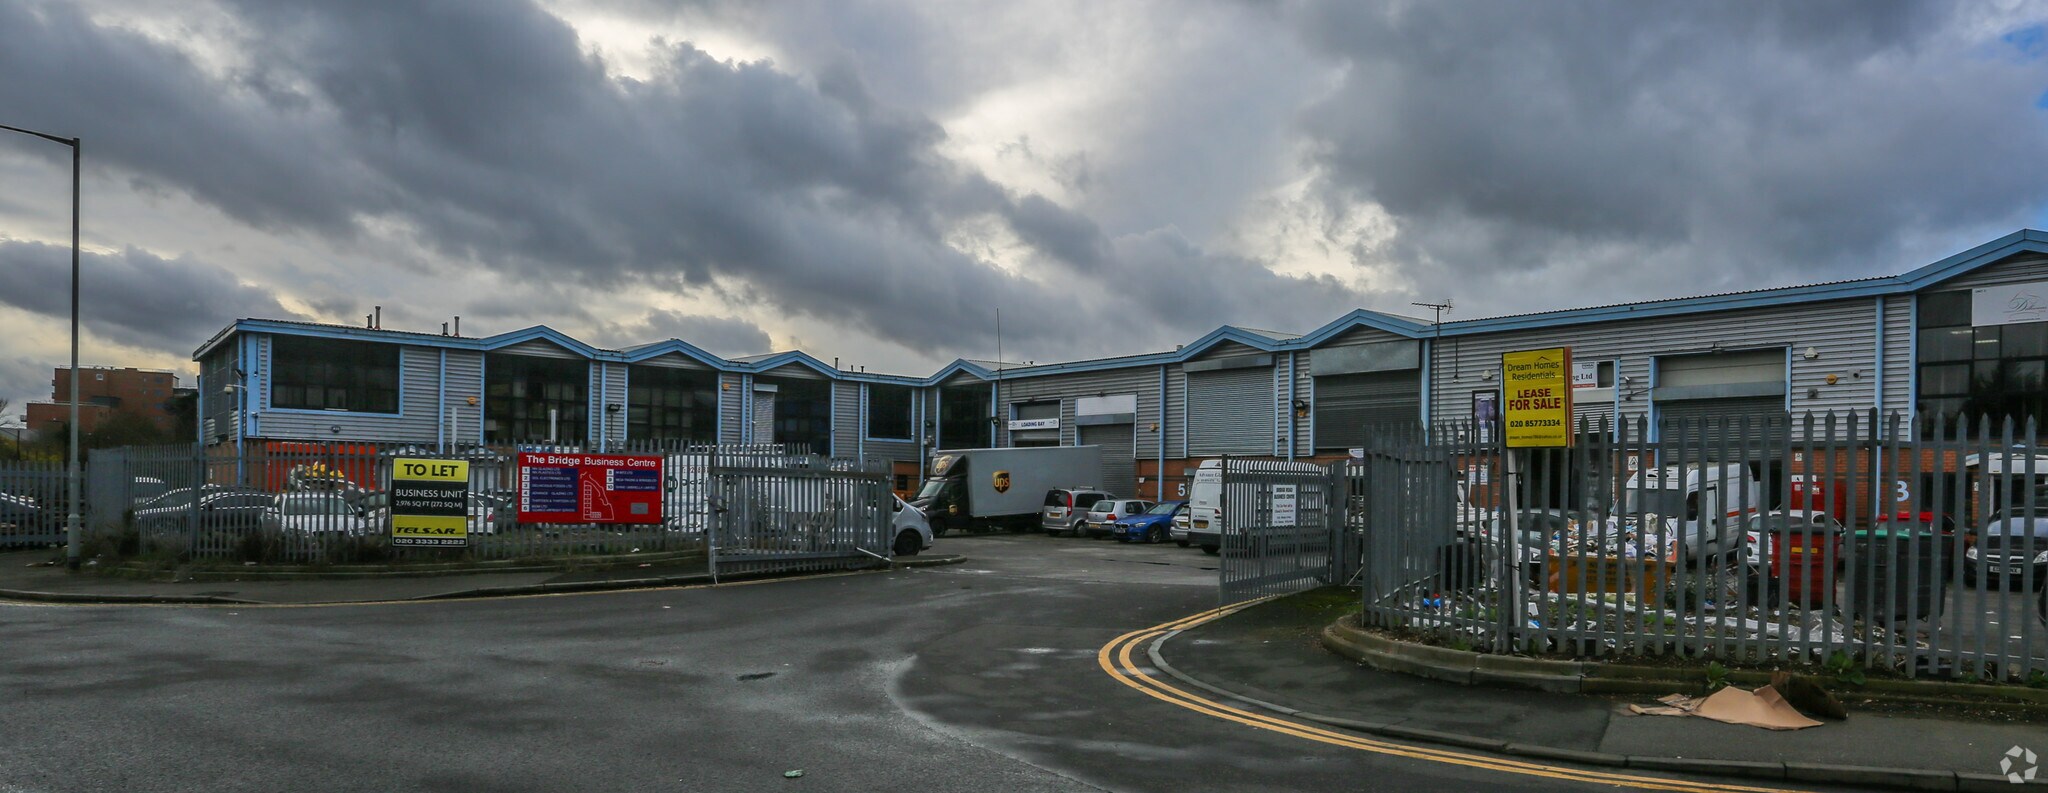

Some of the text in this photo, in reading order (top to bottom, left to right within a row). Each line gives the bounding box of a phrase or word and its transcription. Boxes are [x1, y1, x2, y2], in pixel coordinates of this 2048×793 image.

[1508, 361, 1560, 372] Dream Homes
[1512, 371, 1556, 381] Residentials
[1518, 388, 1551, 398] LEASE
[1509, 398, 1560, 411] FOR SALE
[526, 455, 656, 467] The Bridge Business Centre
[404, 464, 458, 476] TO LET
[994, 478, 1009, 490] ups
[1178, 484, 1185, 496] 5
[396, 489, 463, 498] BUSINESS UNIT
[1896, 480, 1910, 501] 3
[395, 527, 456, 535] TELSAR
